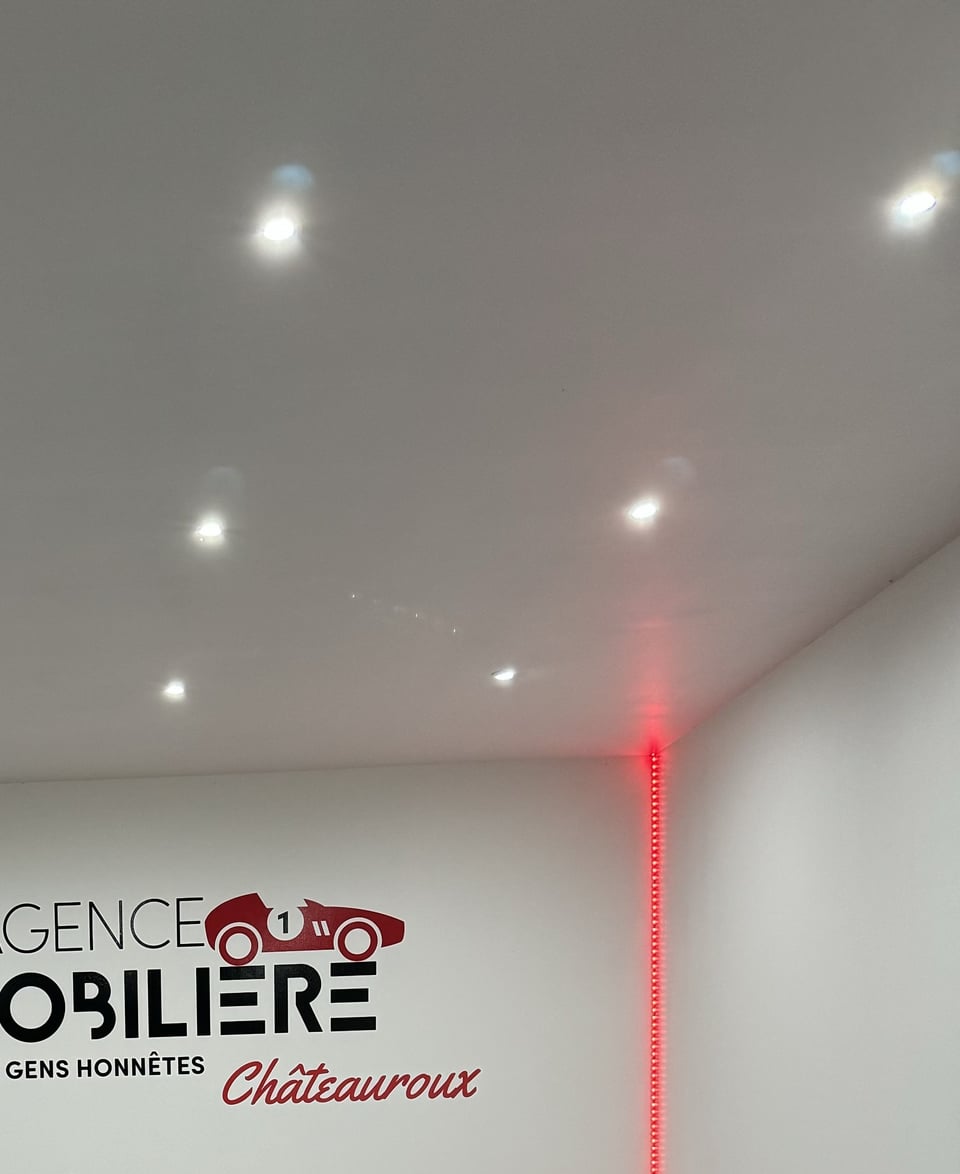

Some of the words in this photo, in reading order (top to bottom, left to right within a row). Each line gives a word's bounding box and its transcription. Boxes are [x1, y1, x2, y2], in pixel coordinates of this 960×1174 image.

[277, 911, 290, 934] 1
[5, 1060, 69, 1080] GENS
[77, 1051, 205, 1078] HONNÊTES
[222, 1057, 481, 1106] Châteauroux
